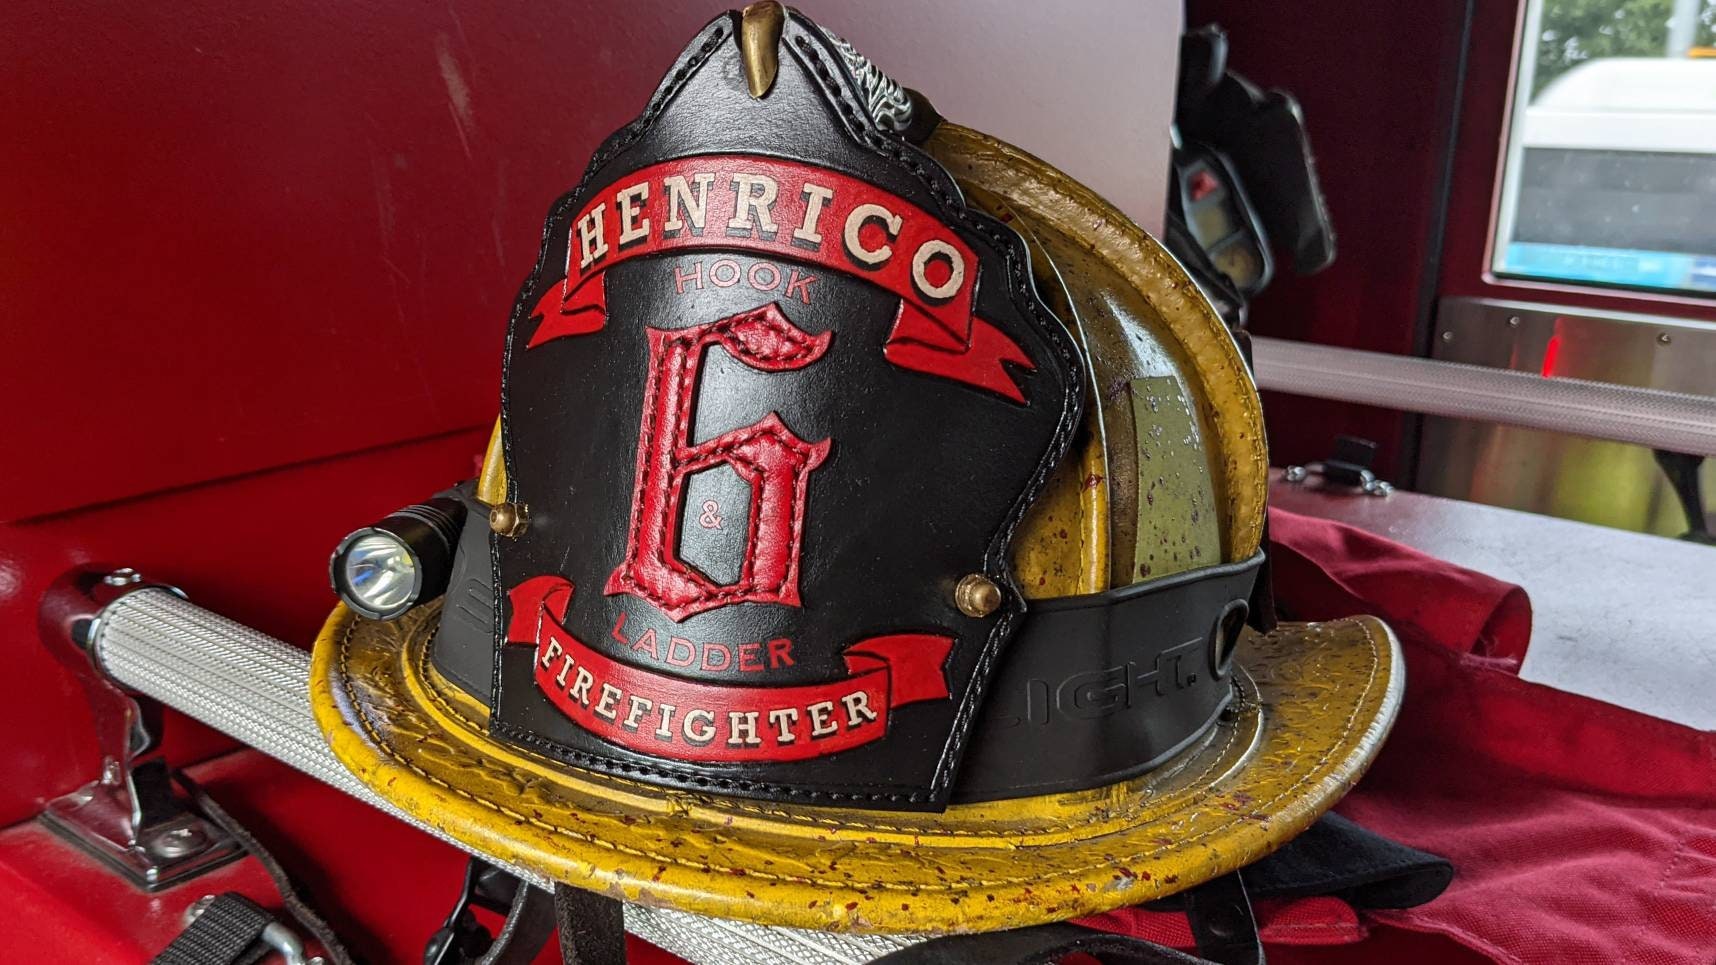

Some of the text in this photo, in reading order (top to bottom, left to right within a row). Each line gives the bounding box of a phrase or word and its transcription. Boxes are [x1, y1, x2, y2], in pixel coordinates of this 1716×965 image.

[576, 172, 965, 299] HENRICO
[674, 259, 819, 304] HOOK
[603, 302, 833, 623] 6
[699, 500, 724, 530] &
[611, 612, 796, 672] LADDER
[541, 637, 878, 746] FIREFIGHTER
